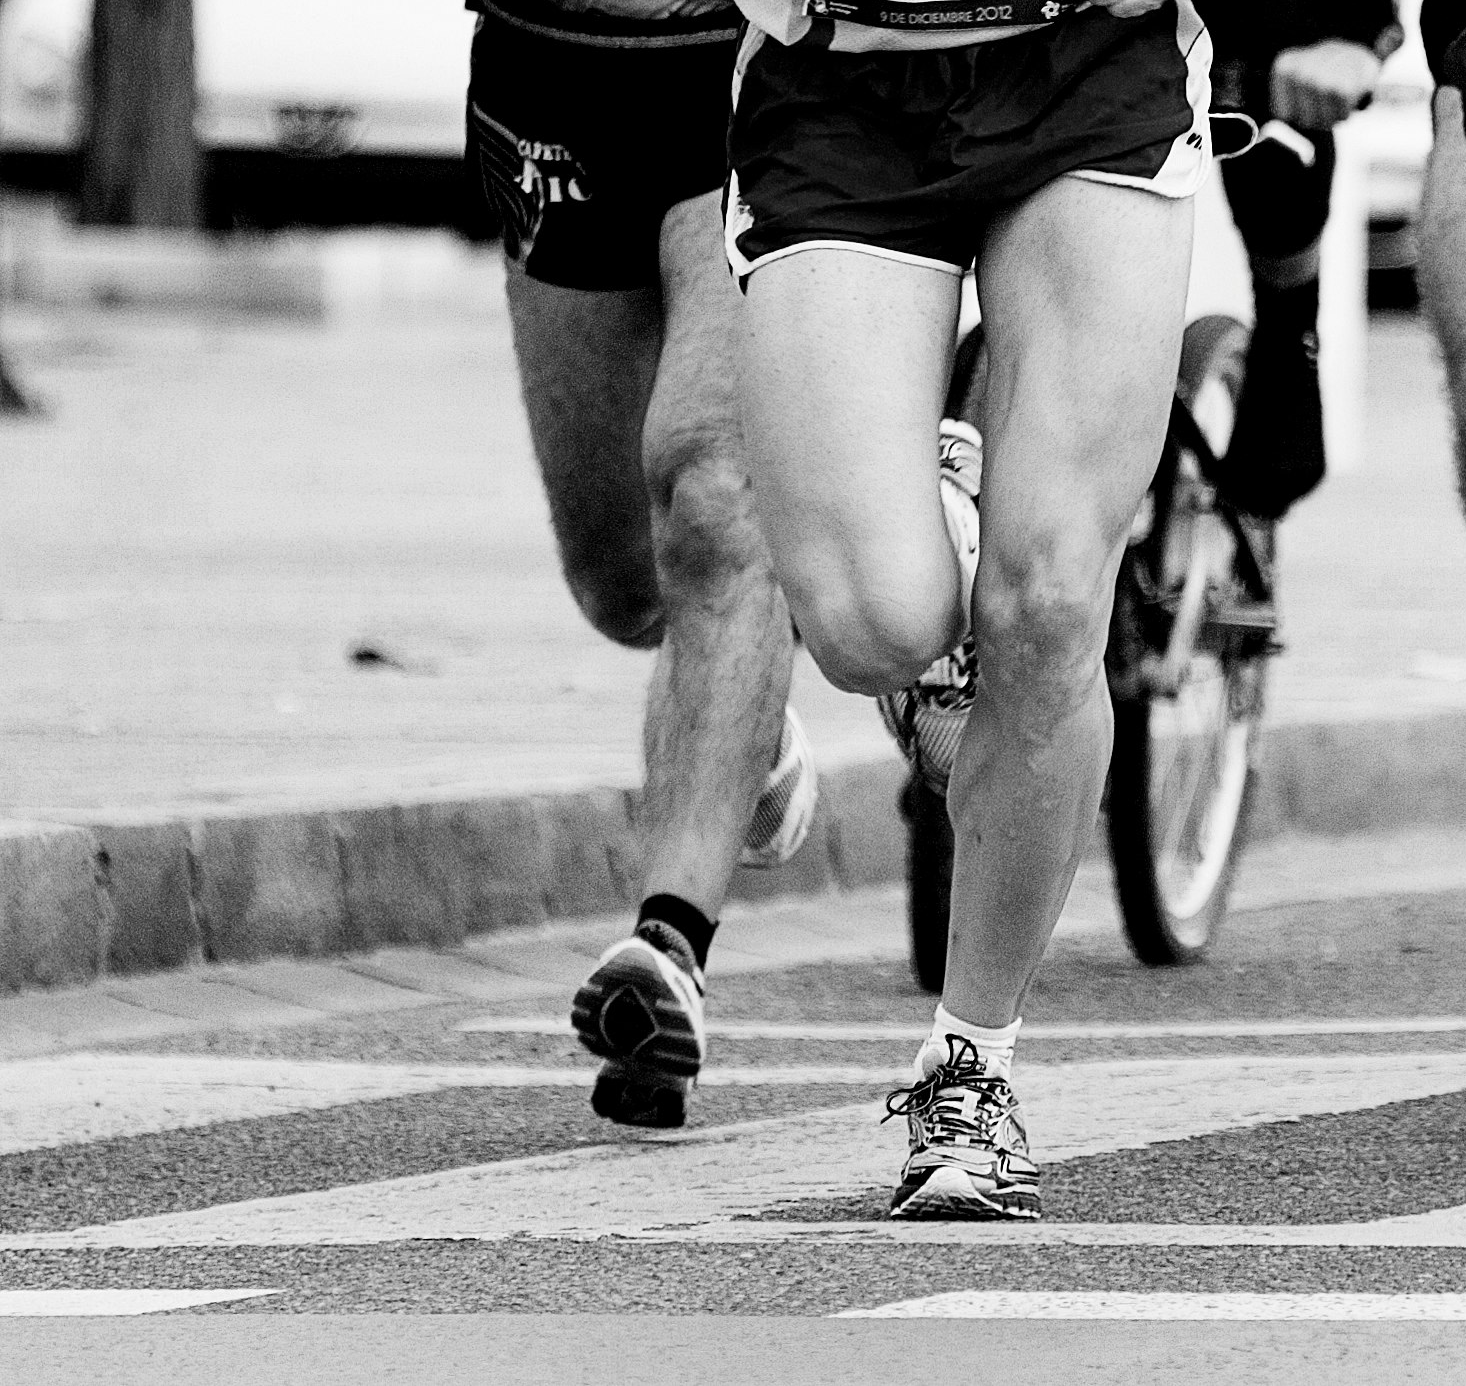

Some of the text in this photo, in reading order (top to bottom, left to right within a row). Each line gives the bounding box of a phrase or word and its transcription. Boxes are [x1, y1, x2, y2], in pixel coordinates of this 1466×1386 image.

[879, 5, 1013, 25] 9 DE DICIEMBRE 2012
